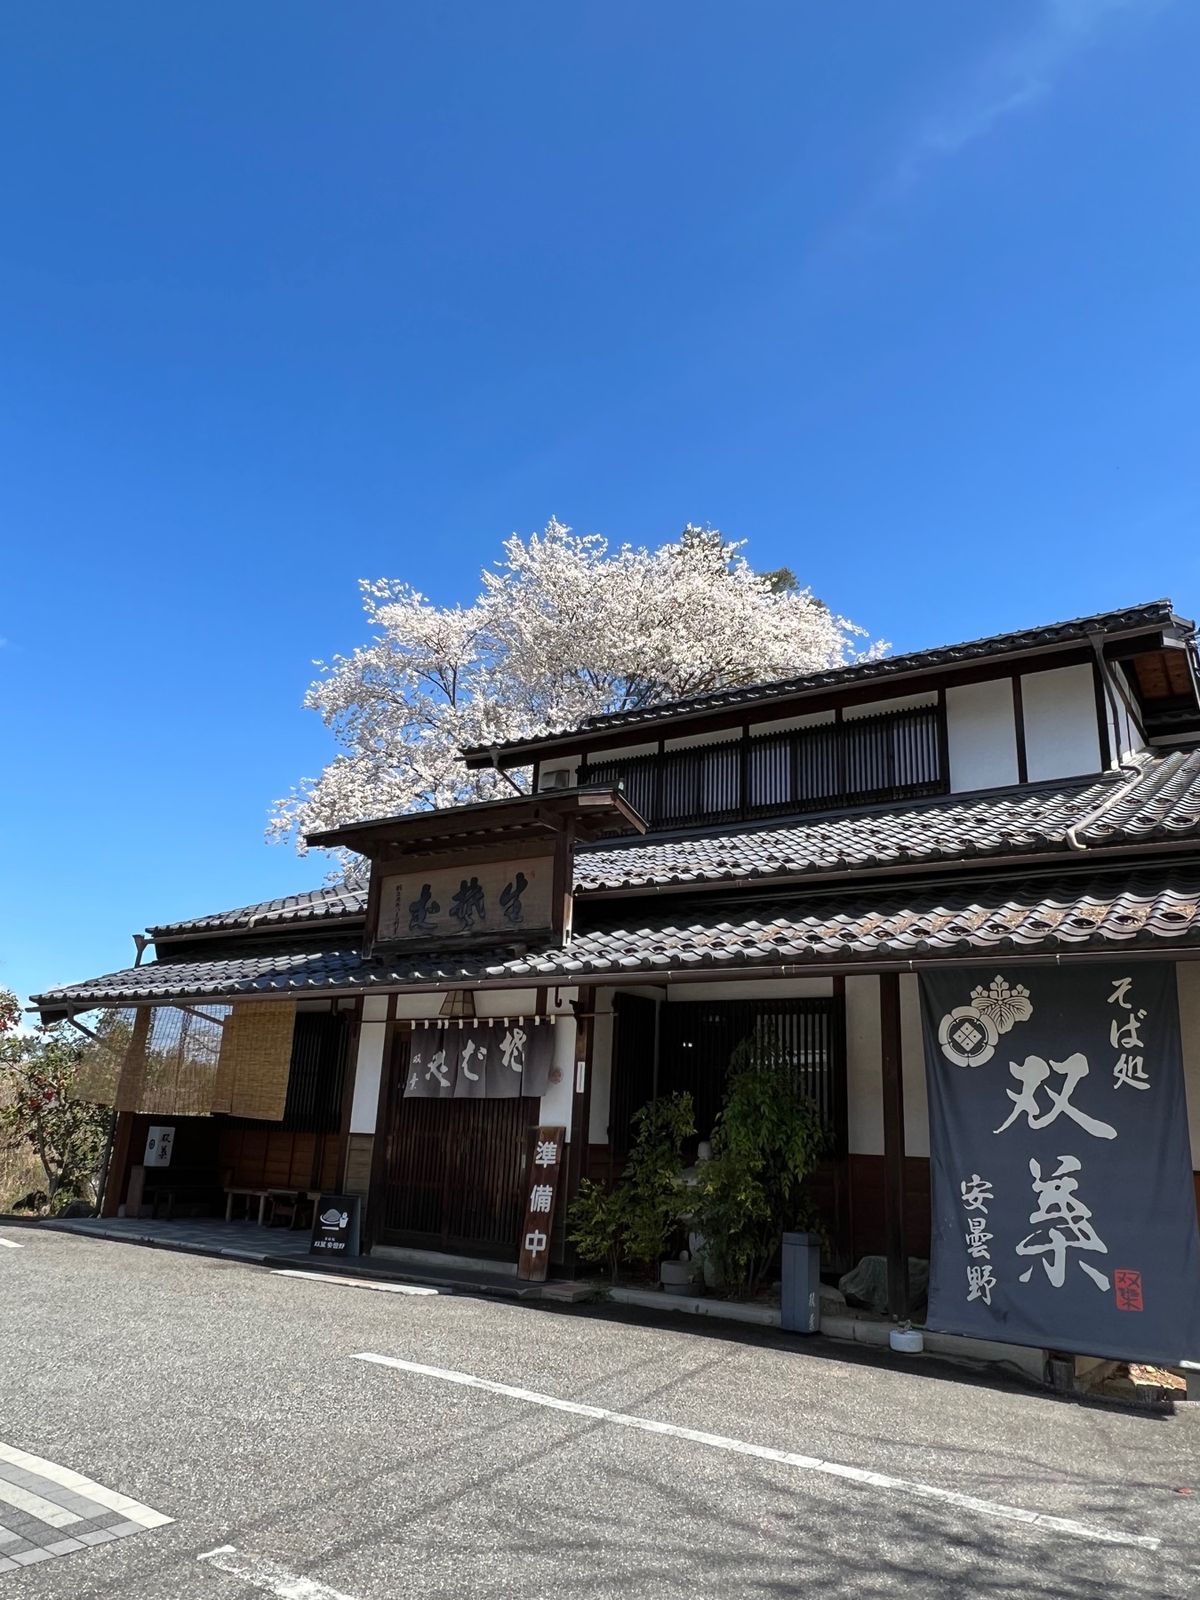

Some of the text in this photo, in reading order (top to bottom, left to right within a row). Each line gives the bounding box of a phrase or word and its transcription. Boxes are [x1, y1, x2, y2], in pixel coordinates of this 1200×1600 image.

[1107, 976, 1151, 1091] そば処
[525, 1141, 558, 1258] 準備中
[992, 1052, 1118, 1292] 双葉
[960, 1173, 998, 1306] 安曇野
